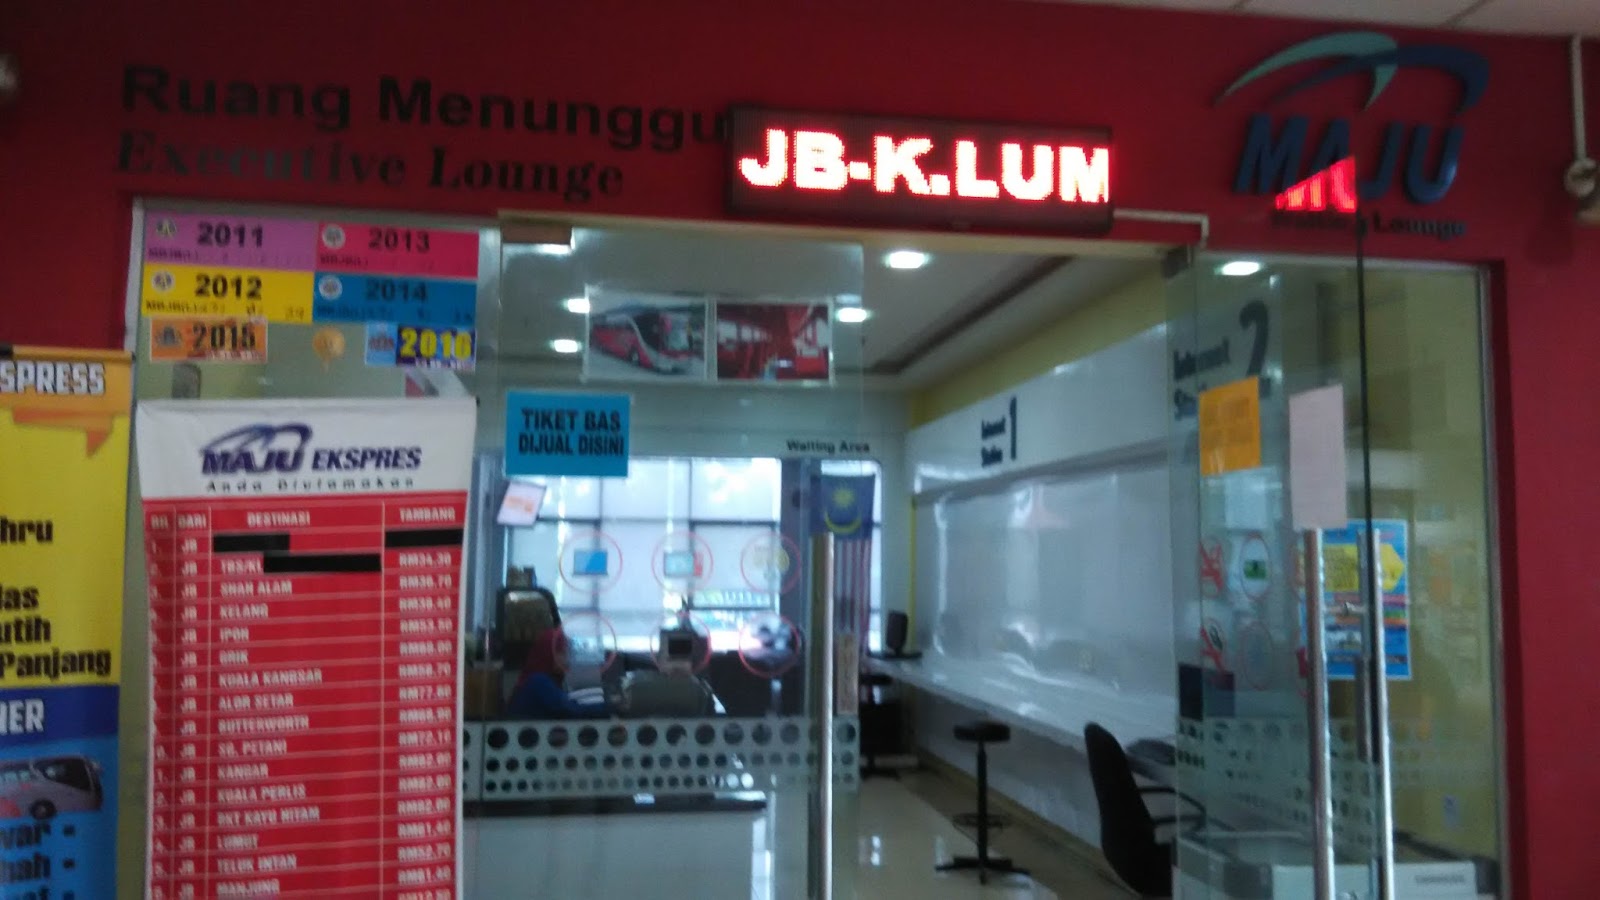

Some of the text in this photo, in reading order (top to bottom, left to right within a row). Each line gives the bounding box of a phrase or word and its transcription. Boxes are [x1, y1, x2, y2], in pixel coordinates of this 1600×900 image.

[122, 63, 727, 153] Ruang Menunggu
[116, 130, 623, 204] Executive Lounge
[738, 128, 1109, 203] JB-K.LUM
[1231, 112, 1463, 204] MAJU
[197, 222, 263, 248] 2011
[369, 226, 430, 253] 2013
[195, 273, 262, 300] 2012
[366, 278, 428, 303] 2014
[0, 359, 106, 395] SPRESS
[521, 407, 621, 432] TIKET BAS
[518, 433, 624, 457] DIJUAL DISINI
[786, 439, 871, 454] Waiting Area
[201, 445, 423, 475] MAJU EKSPRES
[206, 480, 263, 494] Anda
[247, 510, 311, 528] DESTINASI
[0, 583, 40, 611] as
[257, 580, 293, 596] ALAM
[0, 648, 111, 680] Panjang
